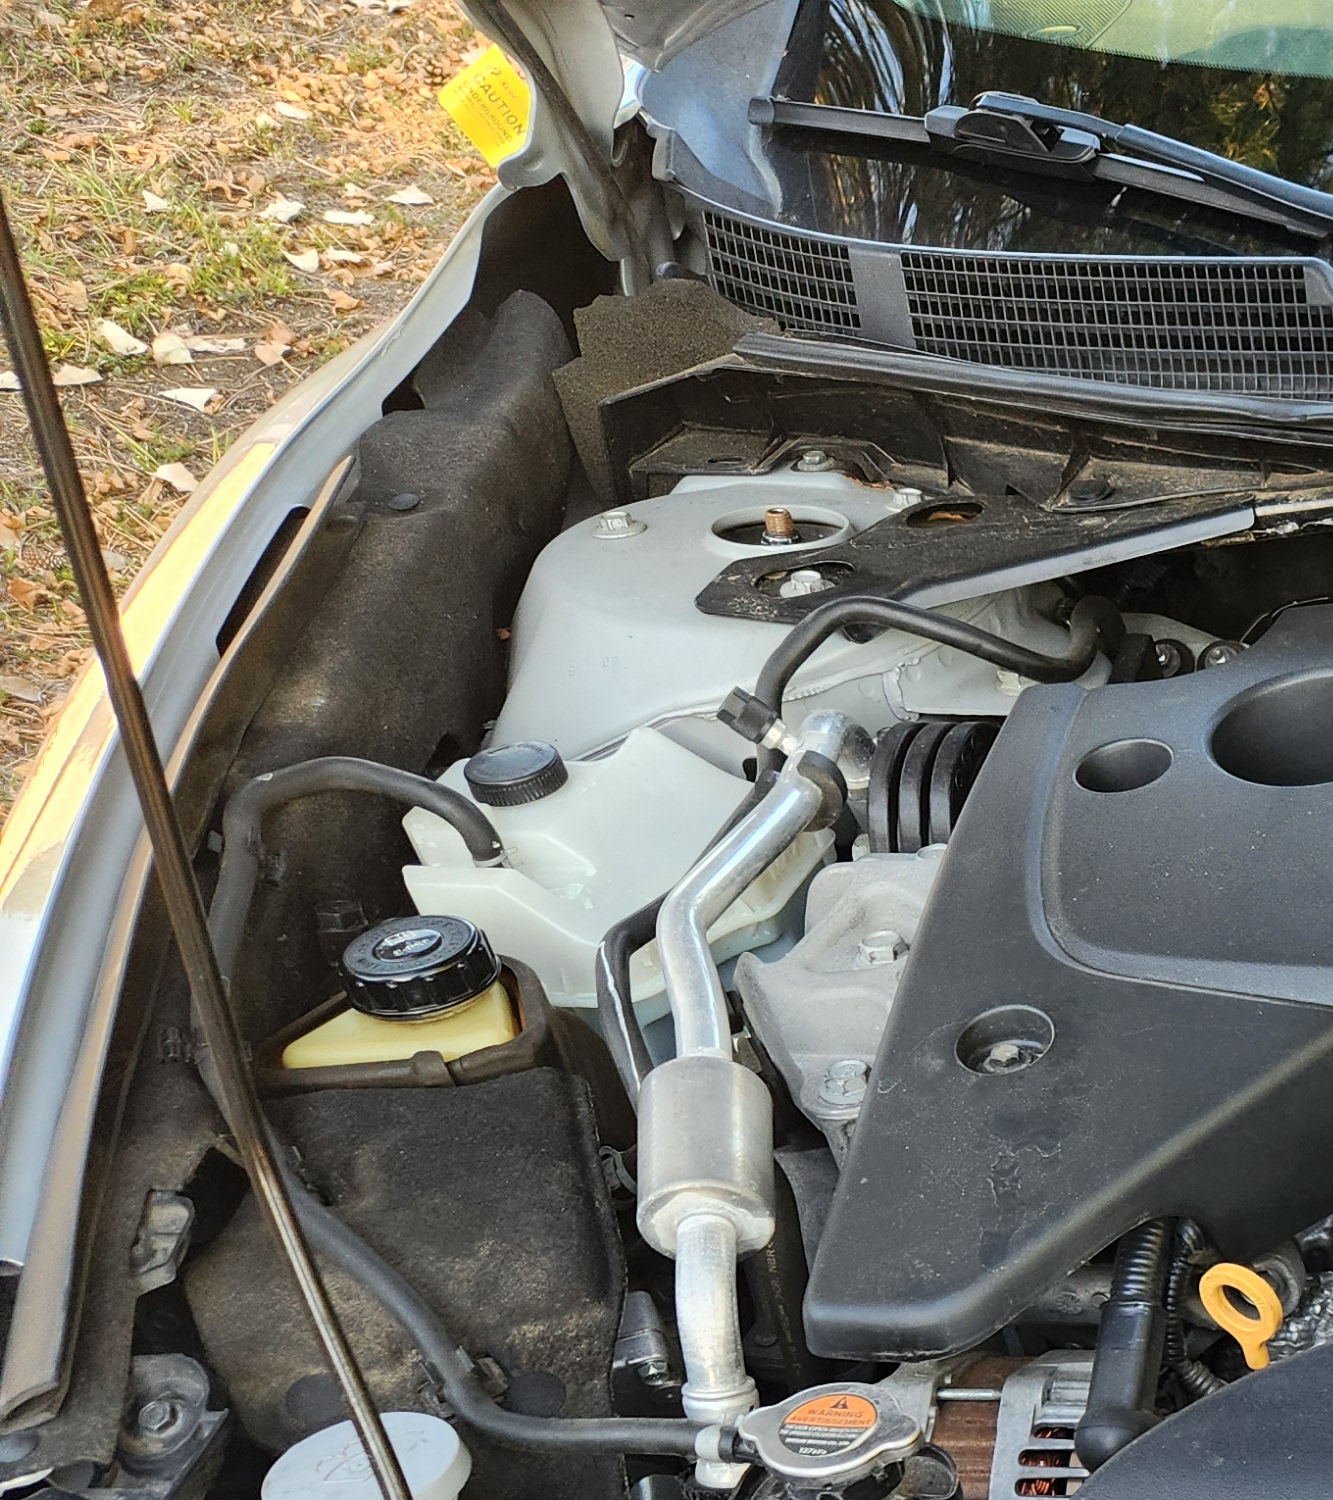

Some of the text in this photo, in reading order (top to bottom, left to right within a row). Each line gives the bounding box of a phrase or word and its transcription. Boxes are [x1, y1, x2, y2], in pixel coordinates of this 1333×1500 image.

[463, 80, 512, 142] UNDERGROUND
[474, 73, 526, 135] CAUTION
[790, 1416, 873, 1425] AVERTISSEMENT
[808, 1409, 864, 1418] WARNING
